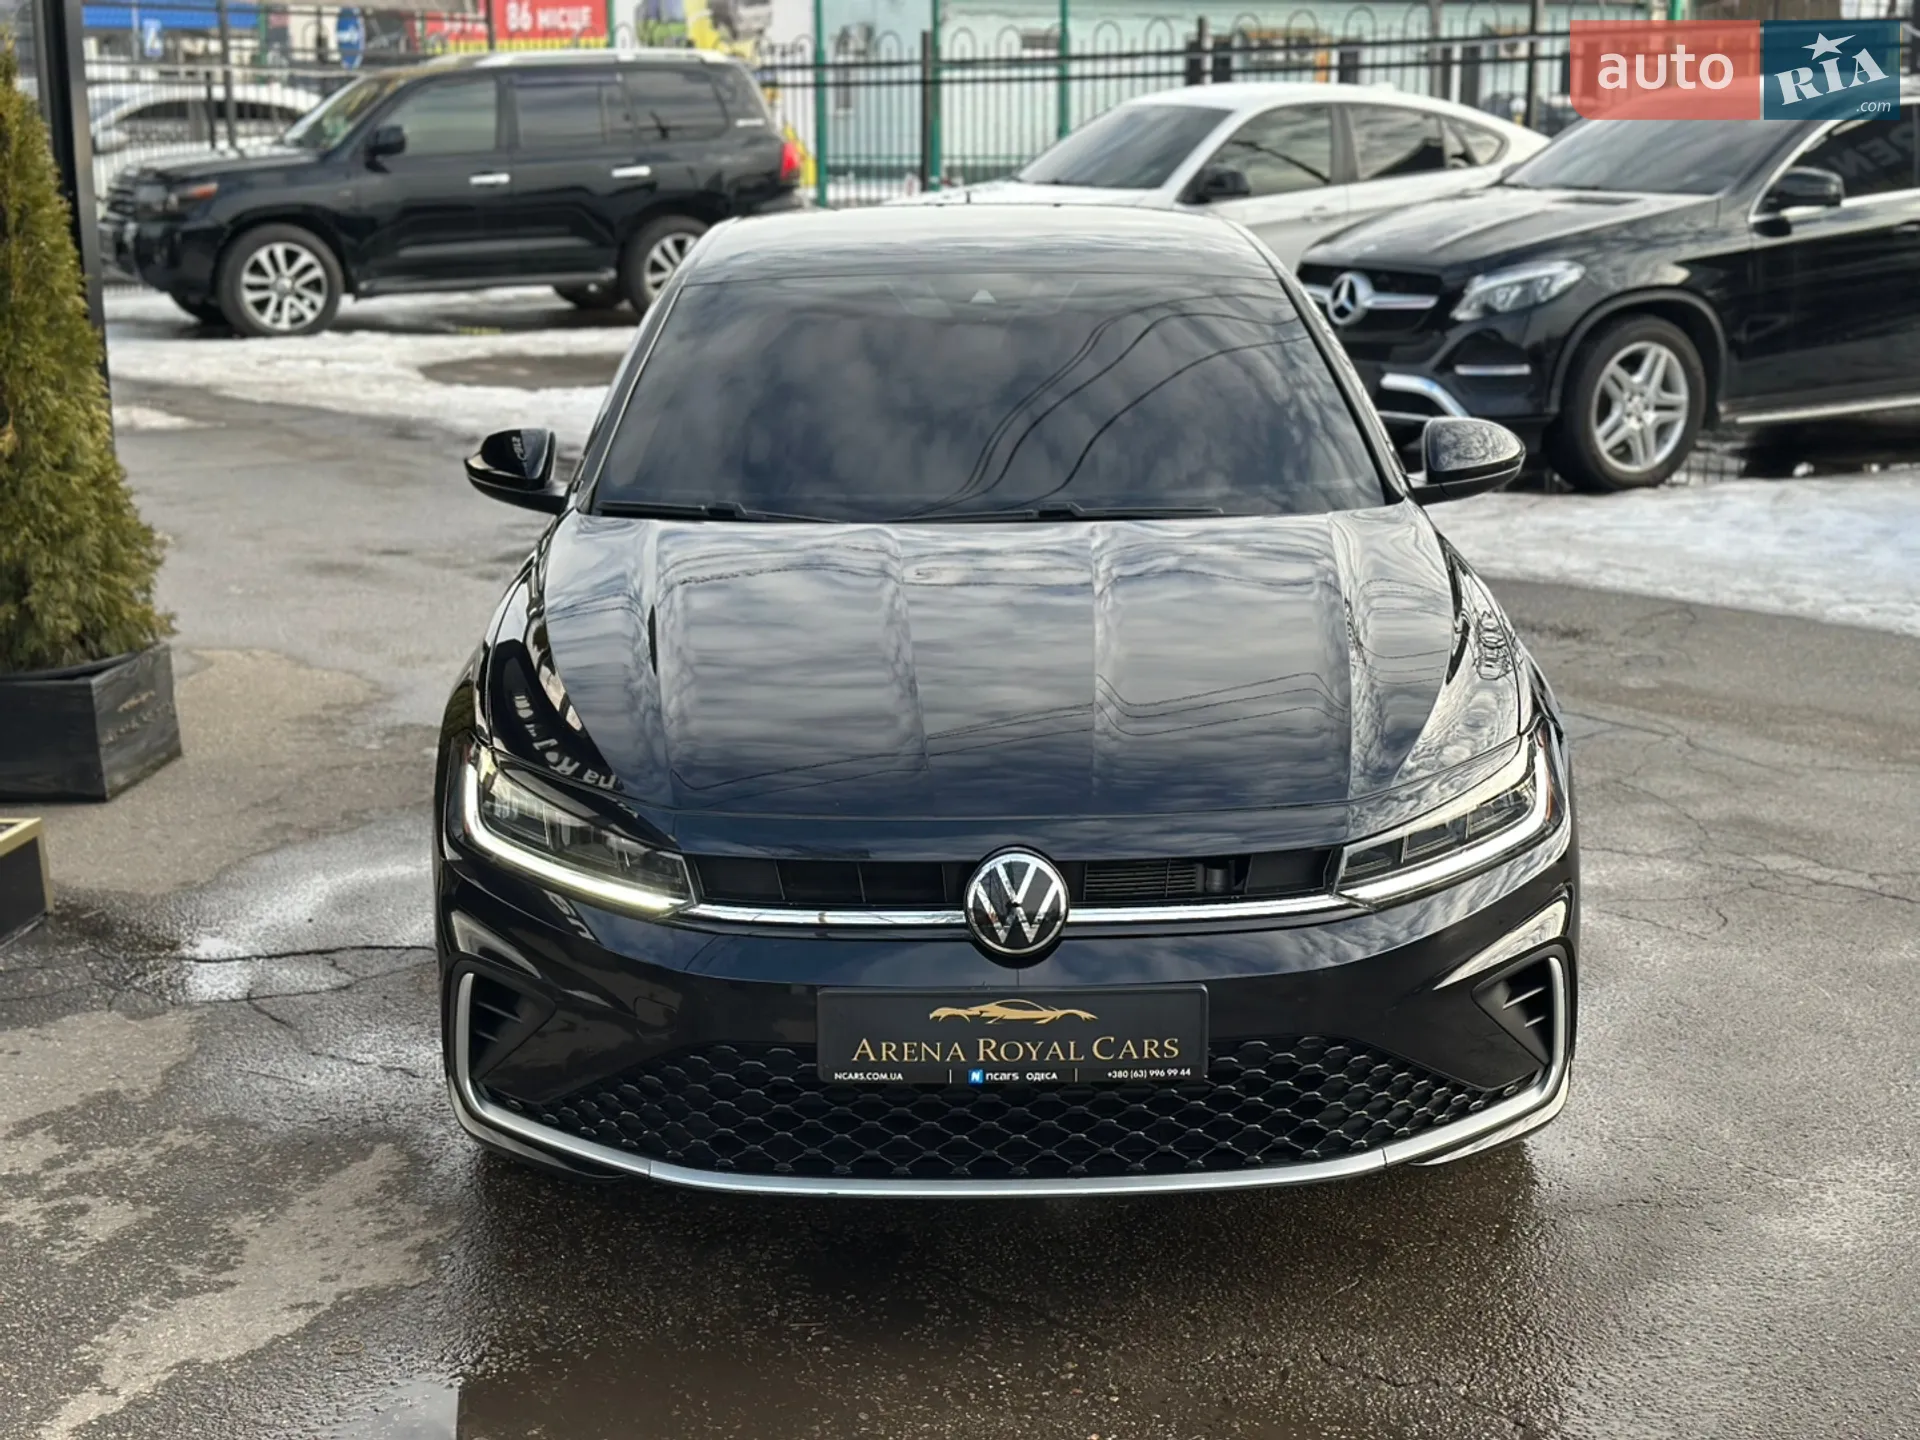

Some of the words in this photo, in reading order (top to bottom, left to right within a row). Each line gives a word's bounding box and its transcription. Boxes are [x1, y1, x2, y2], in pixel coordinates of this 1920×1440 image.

[851, 1036, 966, 1063] ARENA
[976, 1037, 1085, 1063] ROYAL
[1091, 1035, 1180, 1061] CARS
[833, 1071, 904, 1082] NCARS.COM.UA
[1107, 1069, 1129, 1079] +380
[1130, 1069, 1148, 1080] (63)
[1149, 1069, 1166, 1078] 996
[1166, 1067, 1179, 1077] 99
[1180, 1067, 1192, 1077] 44
